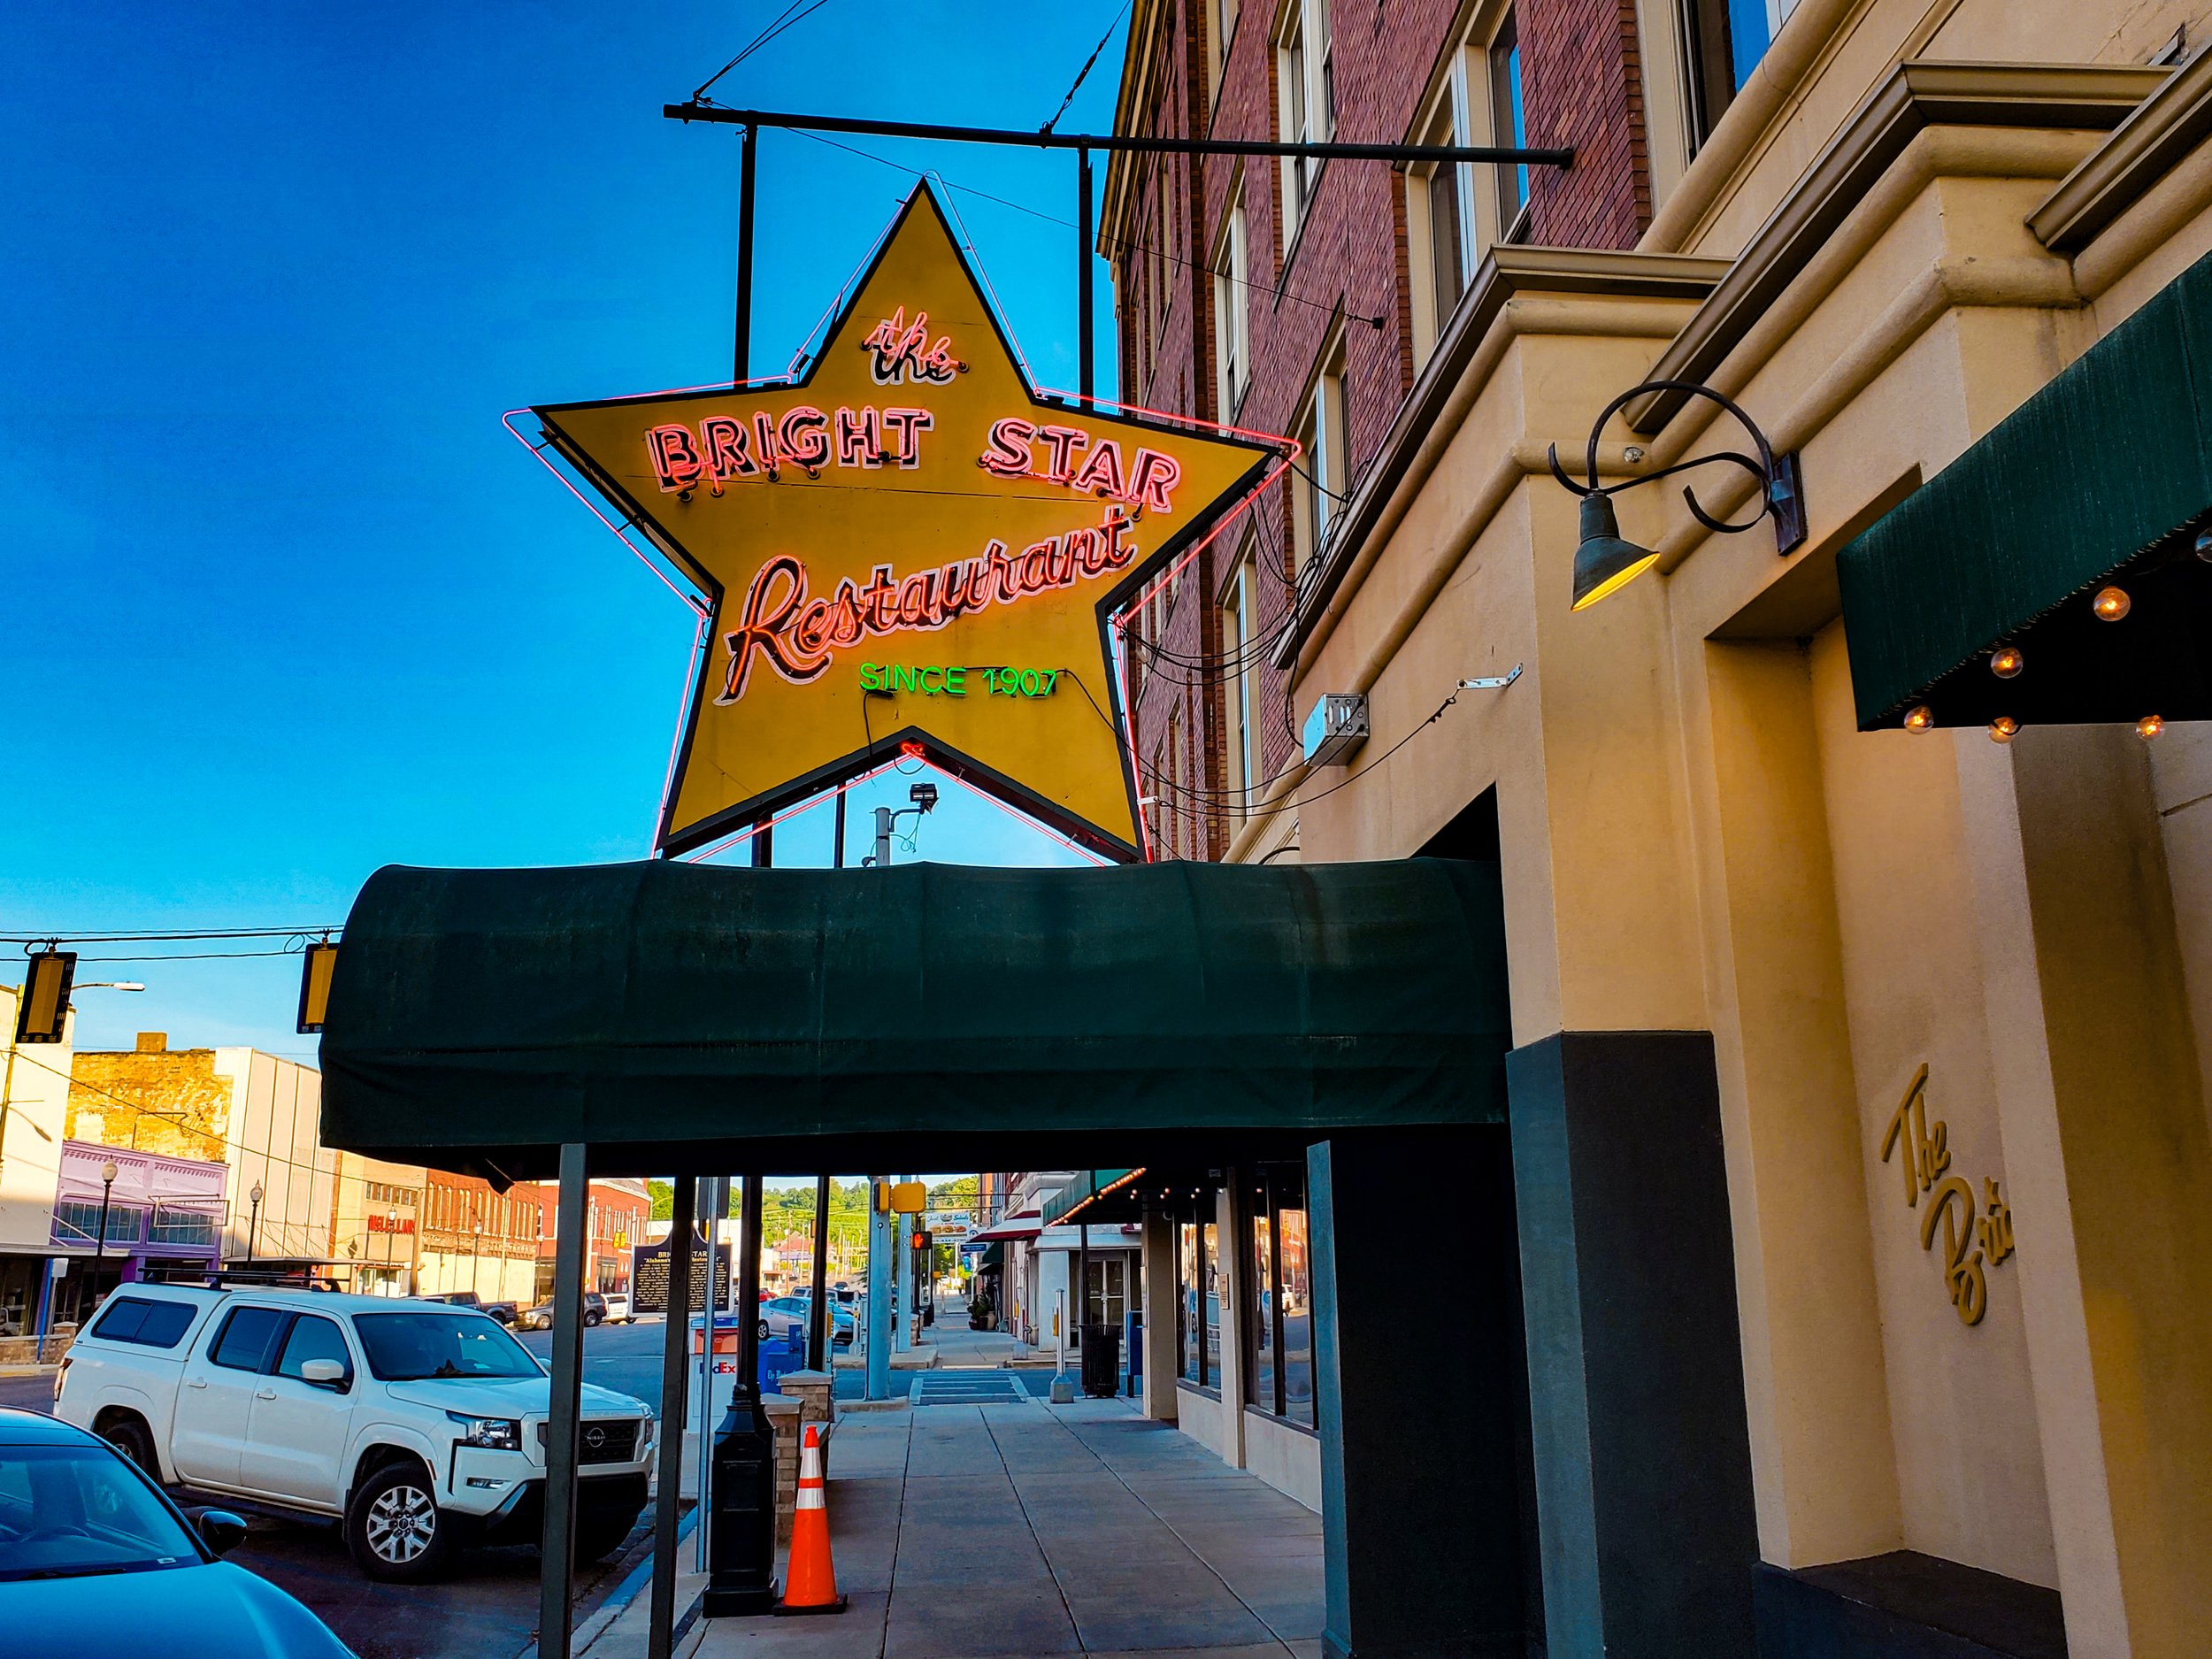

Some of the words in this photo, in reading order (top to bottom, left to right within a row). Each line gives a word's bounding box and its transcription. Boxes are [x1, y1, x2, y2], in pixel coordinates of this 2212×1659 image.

[863, 305, 970, 386] the
[646, 405, 934, 493] BRIGHT
[979, 417, 1181, 513] STAR
[713, 504, 1138, 706] Restaurant
[859, 662, 967, 695] SINCE
[982, 667, 1058, 697] 1907
[1880, 1062, 1951, 1208] The
[699, 1361, 736, 1374] dEx
